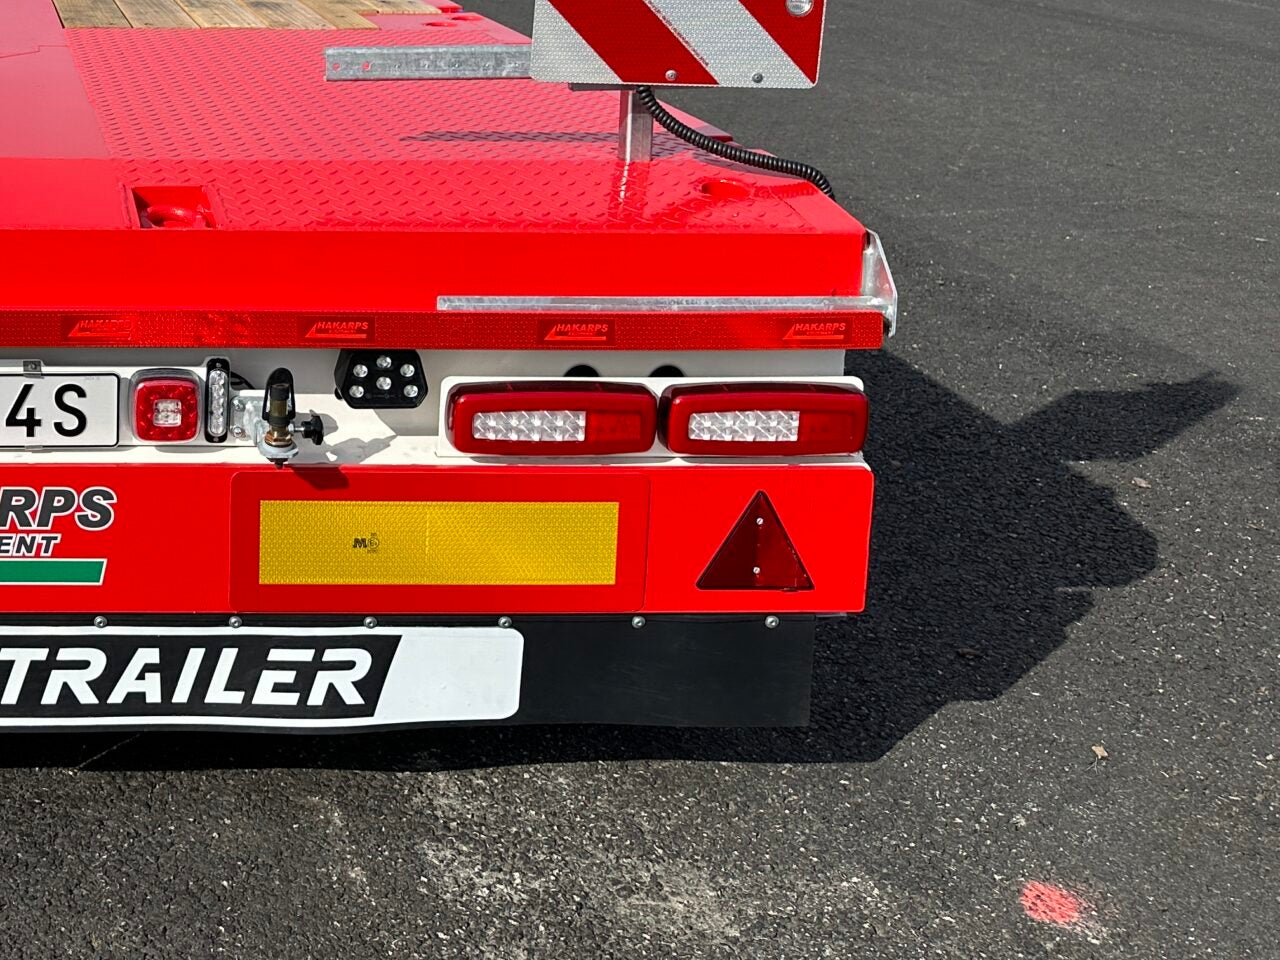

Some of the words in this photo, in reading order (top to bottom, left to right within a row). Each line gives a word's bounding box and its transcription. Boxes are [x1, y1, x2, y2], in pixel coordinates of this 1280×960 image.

[317, 321, 369, 330] HAKARPS
[556, 324, 608, 332] HAKARPS
[795, 322, 846, 331] HAKARPS
